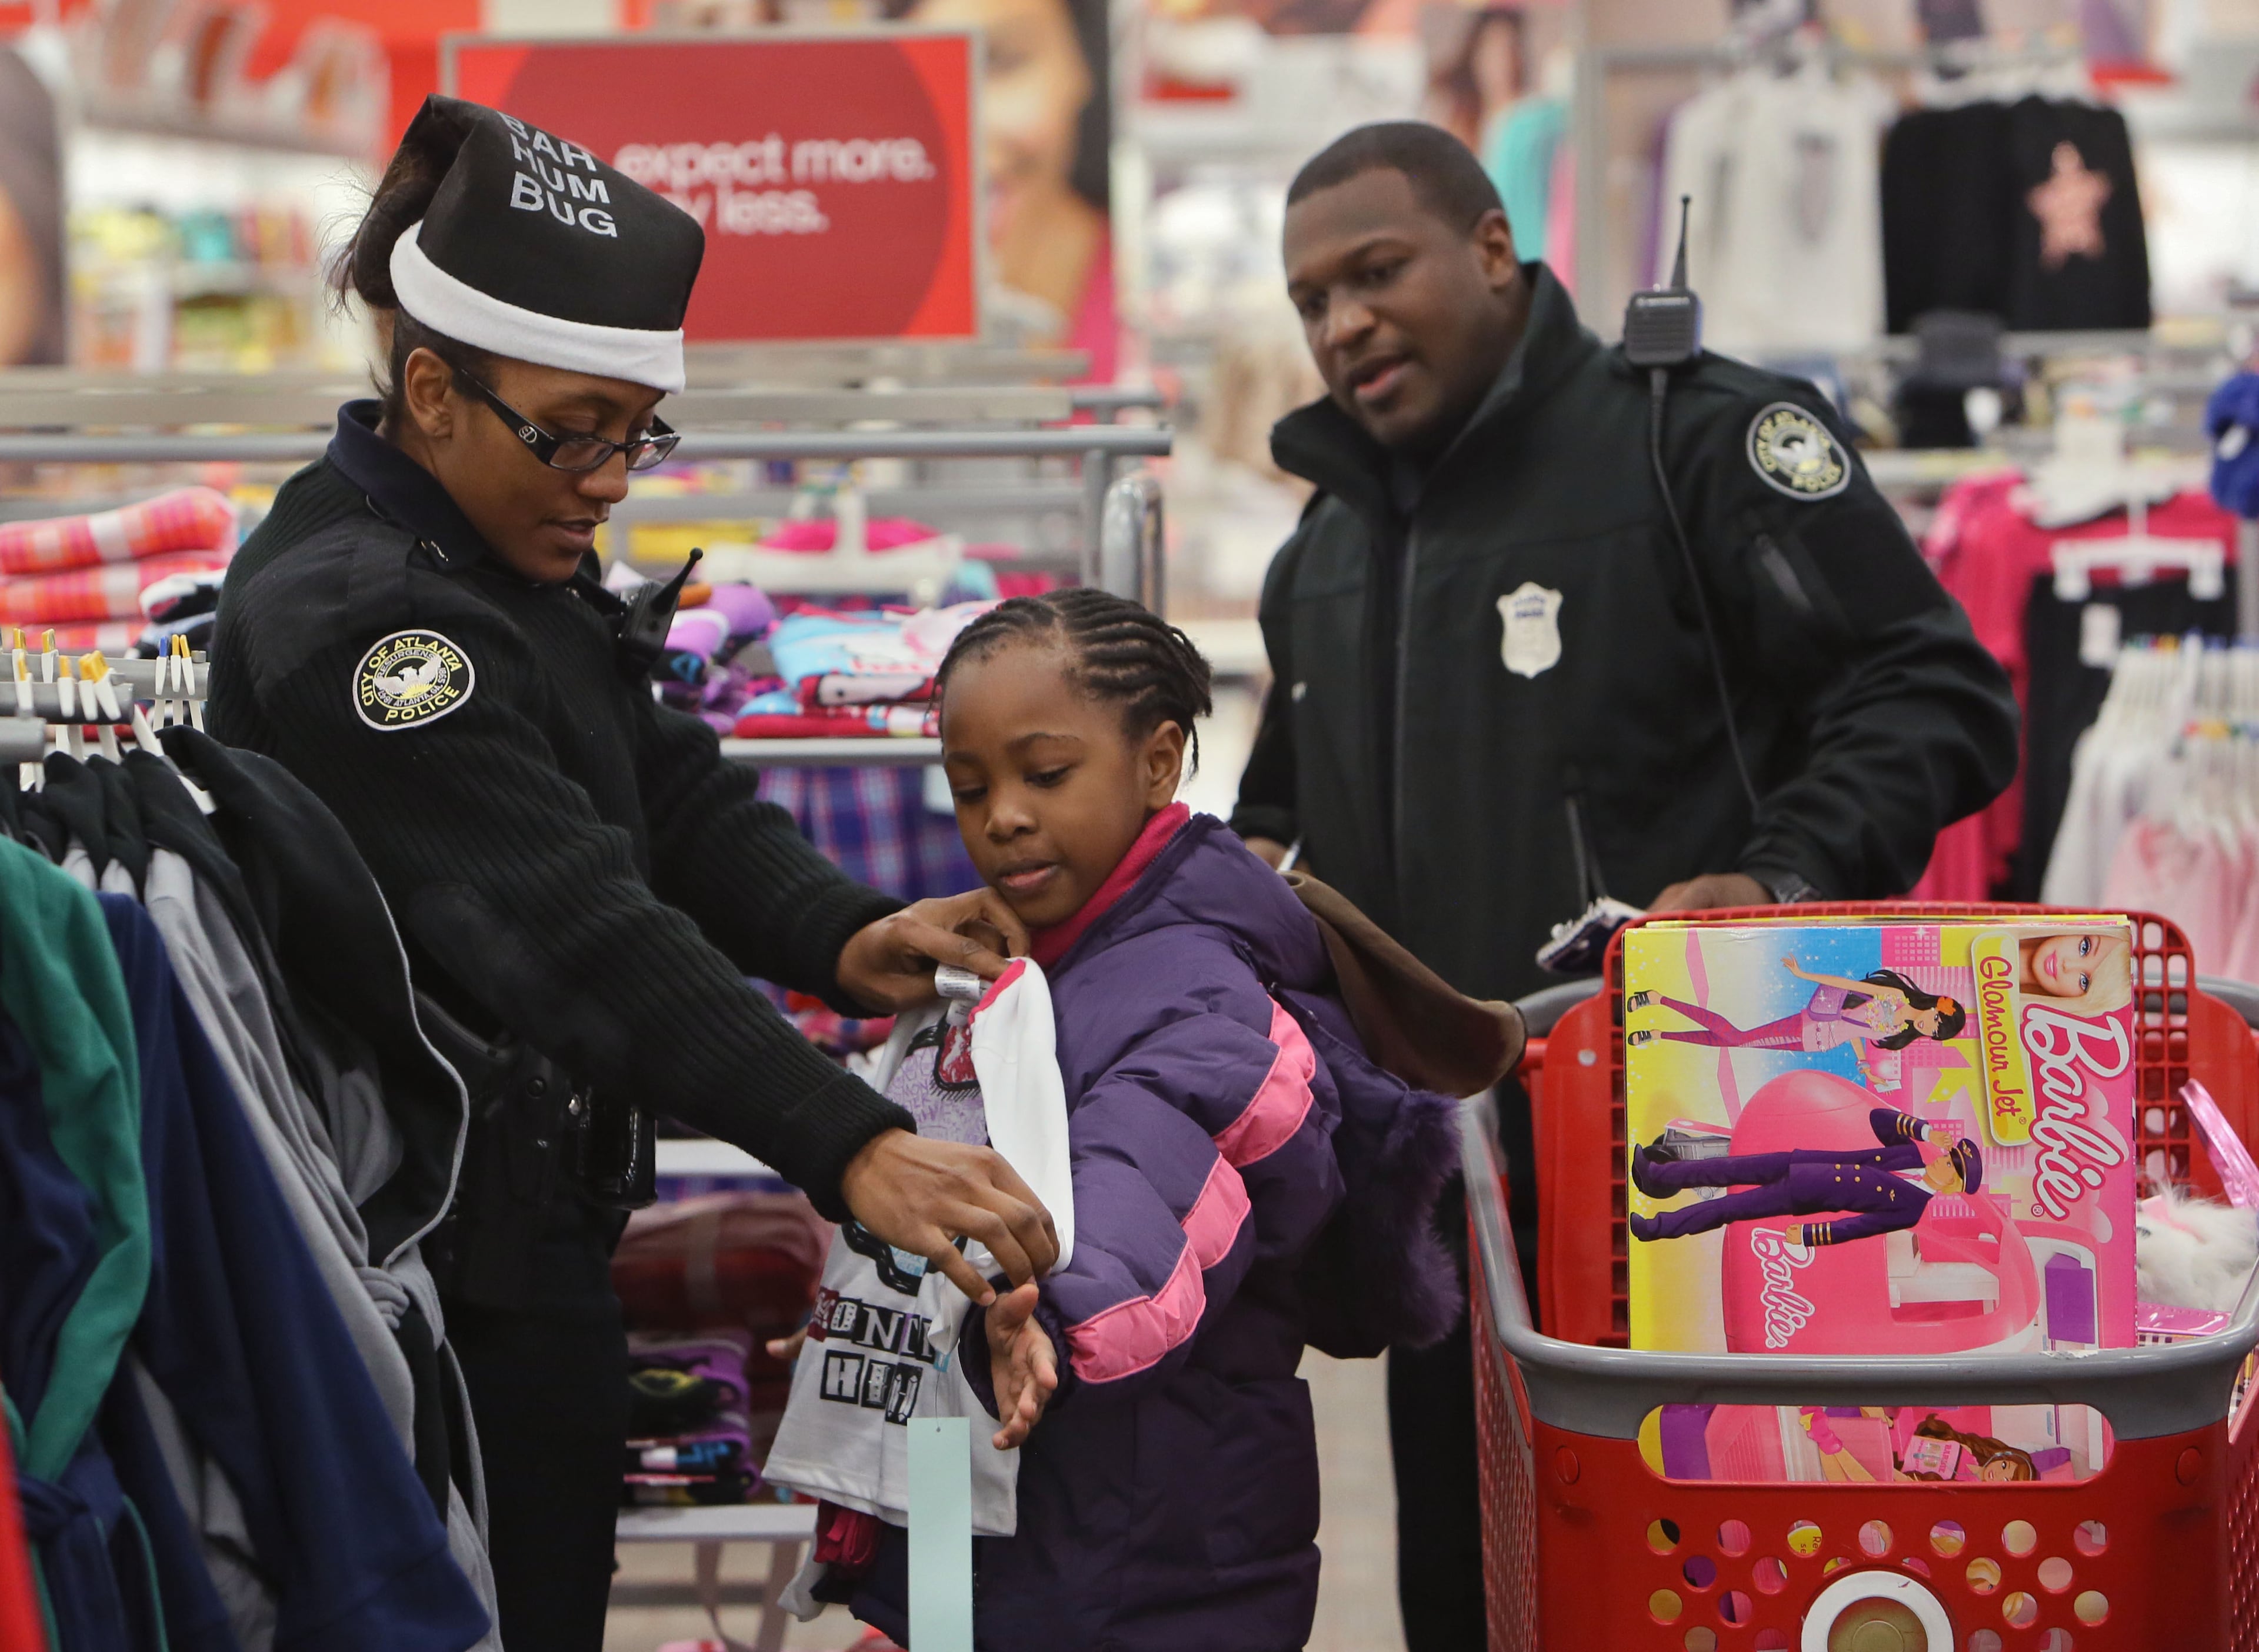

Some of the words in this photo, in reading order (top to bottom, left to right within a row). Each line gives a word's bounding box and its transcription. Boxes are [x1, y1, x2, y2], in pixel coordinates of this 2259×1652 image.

[497, 111, 597, 172] BAH
[510, 133, 611, 204] HUM
[614, 132, 785, 189] expect
[792, 137, 937, 183] more.
[510, 171, 617, 238] BUG
[716, 180, 830, 235] less.
[361, 672, 375, 706] CITY
[369, 646, 388, 669] OF
[394, 637, 462, 671] ATLANTA
[377, 650, 435, 678] RESURGENS
[385, 686, 460, 722] POLICE
[1980, 956, 2013, 1072] Glamour
[1993, 1080, 2024, 1117] Jet
[2022, 1006, 2131, 1220] Barbie
[1752, 1228, 1814, 1346] Barbie
